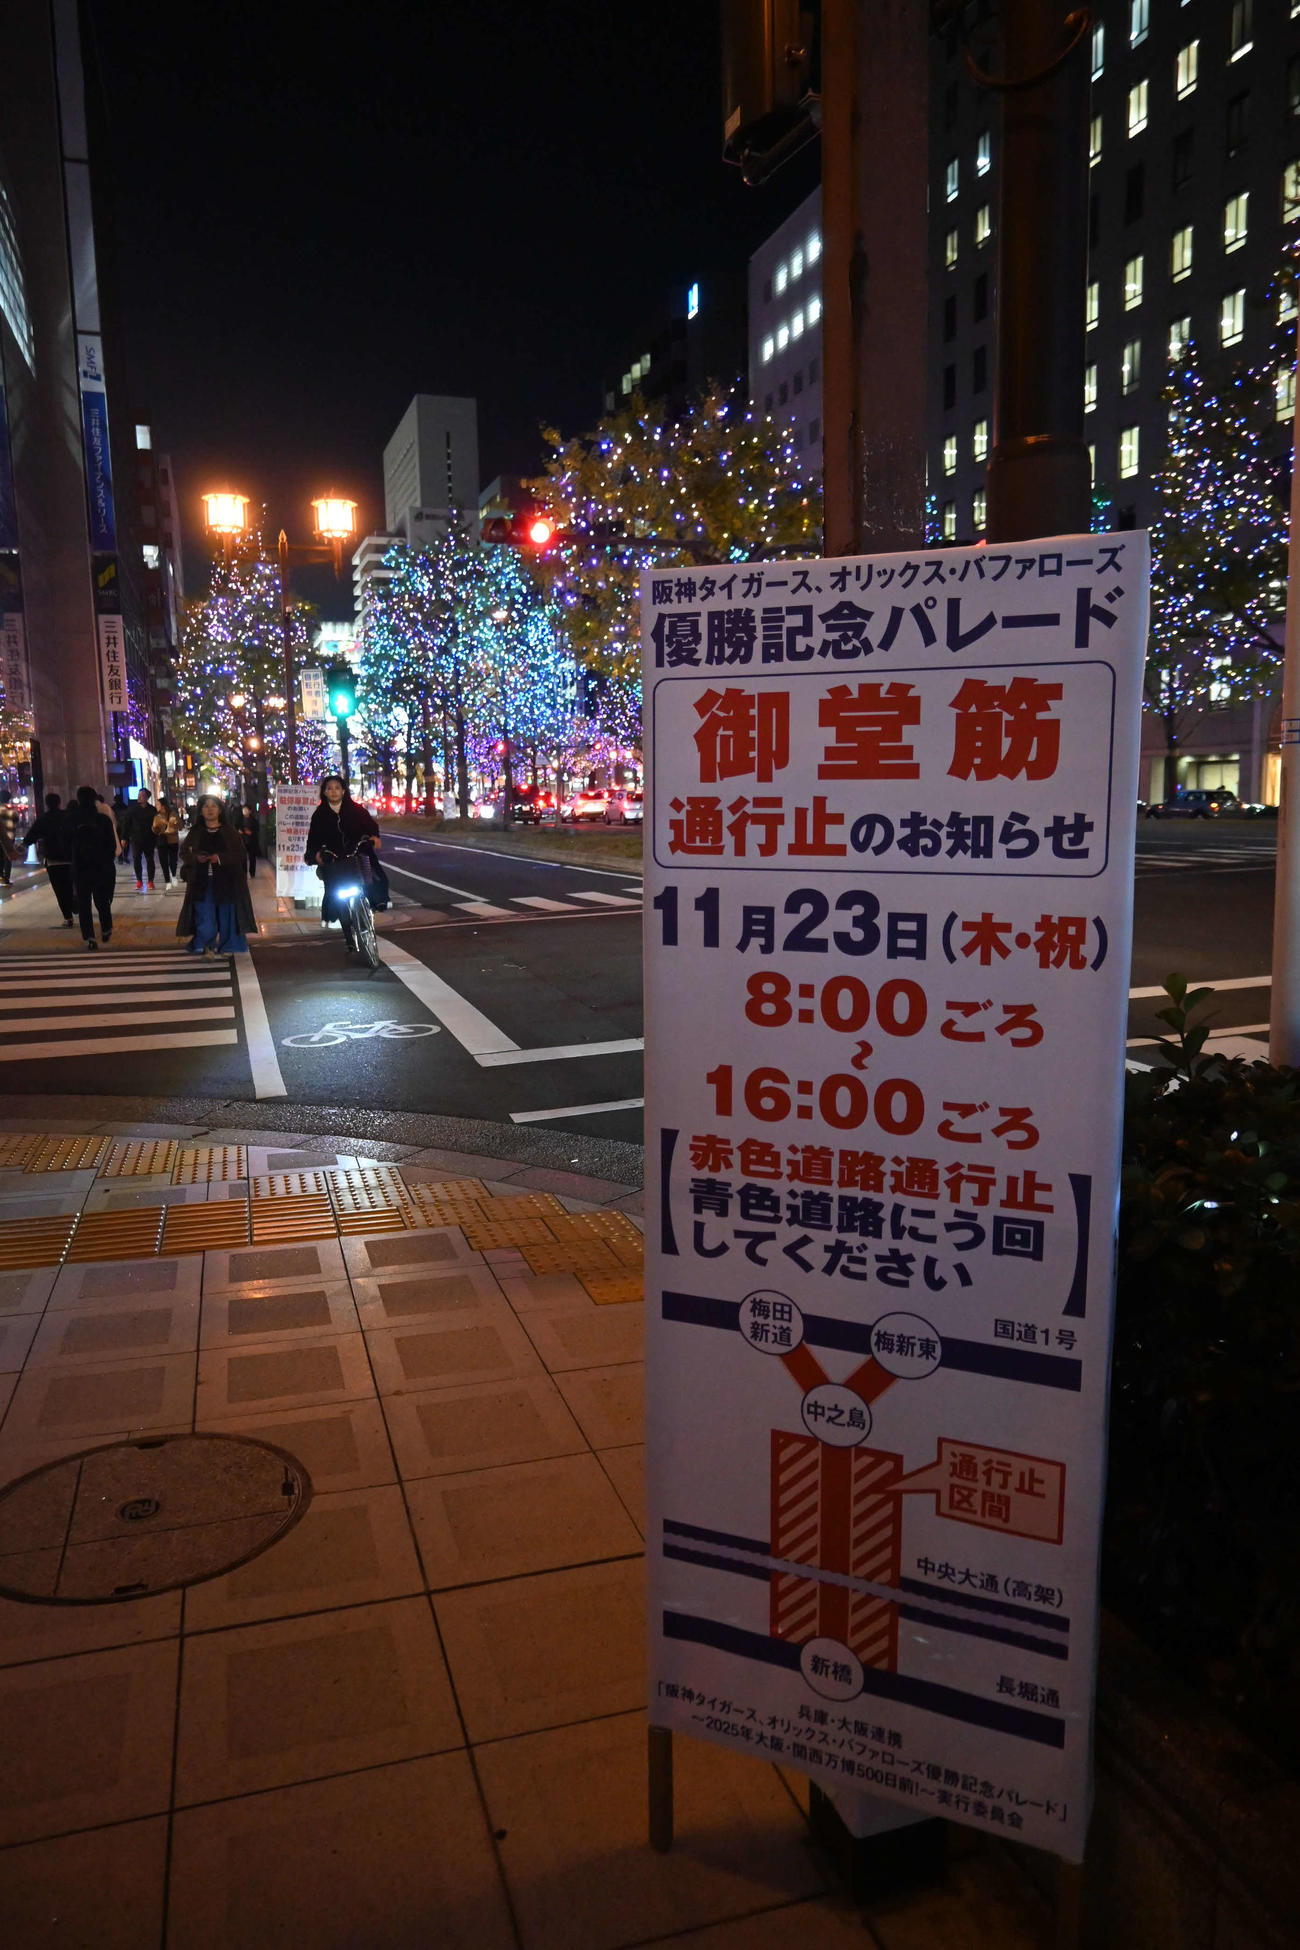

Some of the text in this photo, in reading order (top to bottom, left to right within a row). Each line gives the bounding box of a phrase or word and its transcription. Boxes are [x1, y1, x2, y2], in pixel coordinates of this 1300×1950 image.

[651, 544, 1126, 605] 阪神タイガース、オリックス・バファローズ
[651, 587, 1126, 668] 優勝記念パレード
[103, 620, 123, 705] 三井住友銀行
[693, 676, 1064, 783] 御堂筋
[668, 795, 1095, 860] 通行止のお知らせ
[688, 1134, 1055, 1214] 赤色道路通行止
[688, 1177, 1046, 1262] 青色道路にう回
[692, 1221, 973, 1292] してください
[749, 1298, 793, 1323] 梅田
[749, 1321, 793, 1348] 新道
[993, 1319, 1078, 1351] 国道1号
[873, 1331, 938, 1362] 梅新東
[806, 1400, 867, 1431] 中之島
[948, 1451, 1047, 1500] 通行止
[948, 1487, 1012, 1525] 区間
[916, 1556, 1064, 1609] 中央大通(高架)
[810, 1654, 853, 1686] 新橋
[995, 1675, 1061, 1709] 長堀通
